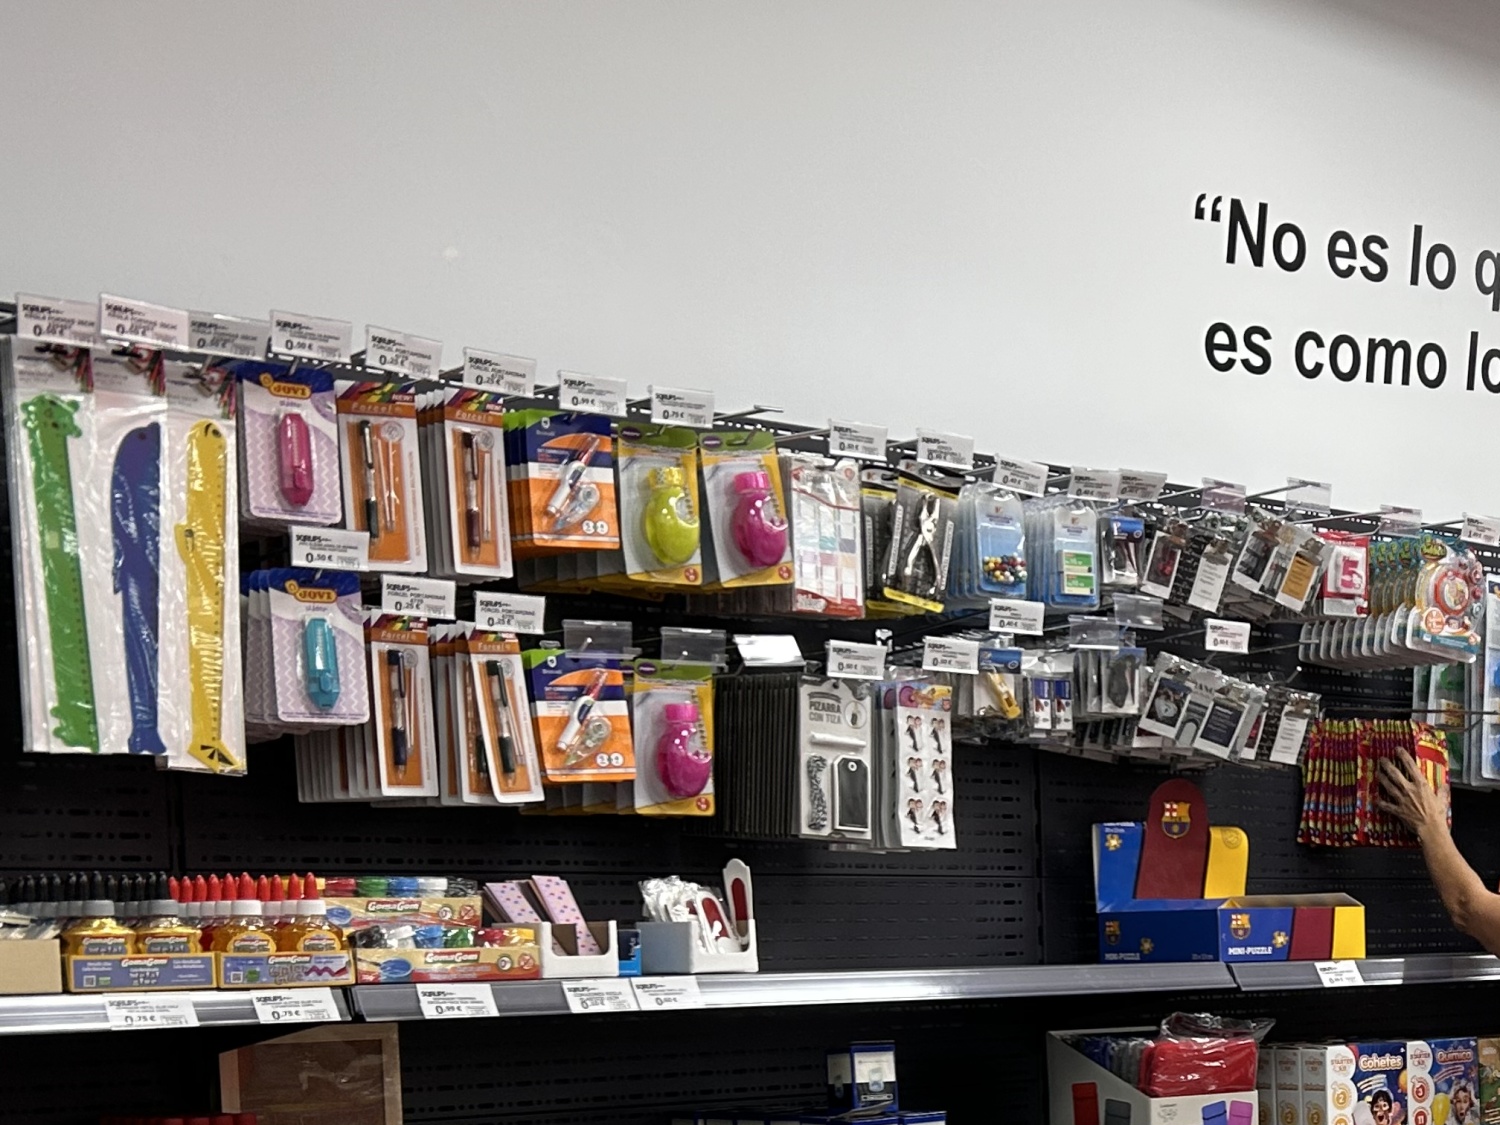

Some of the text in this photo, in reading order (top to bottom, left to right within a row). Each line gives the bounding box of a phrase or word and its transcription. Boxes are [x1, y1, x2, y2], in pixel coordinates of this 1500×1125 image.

[1326, 229, 1389, 282] es
[1410, 224, 1456, 290] lo
[1204, 322, 1273, 375] es
[1295, 330, 1447, 389] como
[275, 383, 306, 396] JOVI
[300, 589, 333, 600] JOVI
[809, 701, 842, 714] PIZARRA
[808, 712, 842, 725] CON TIZA
[1361, 1055, 1402, 1069] Cohetes
